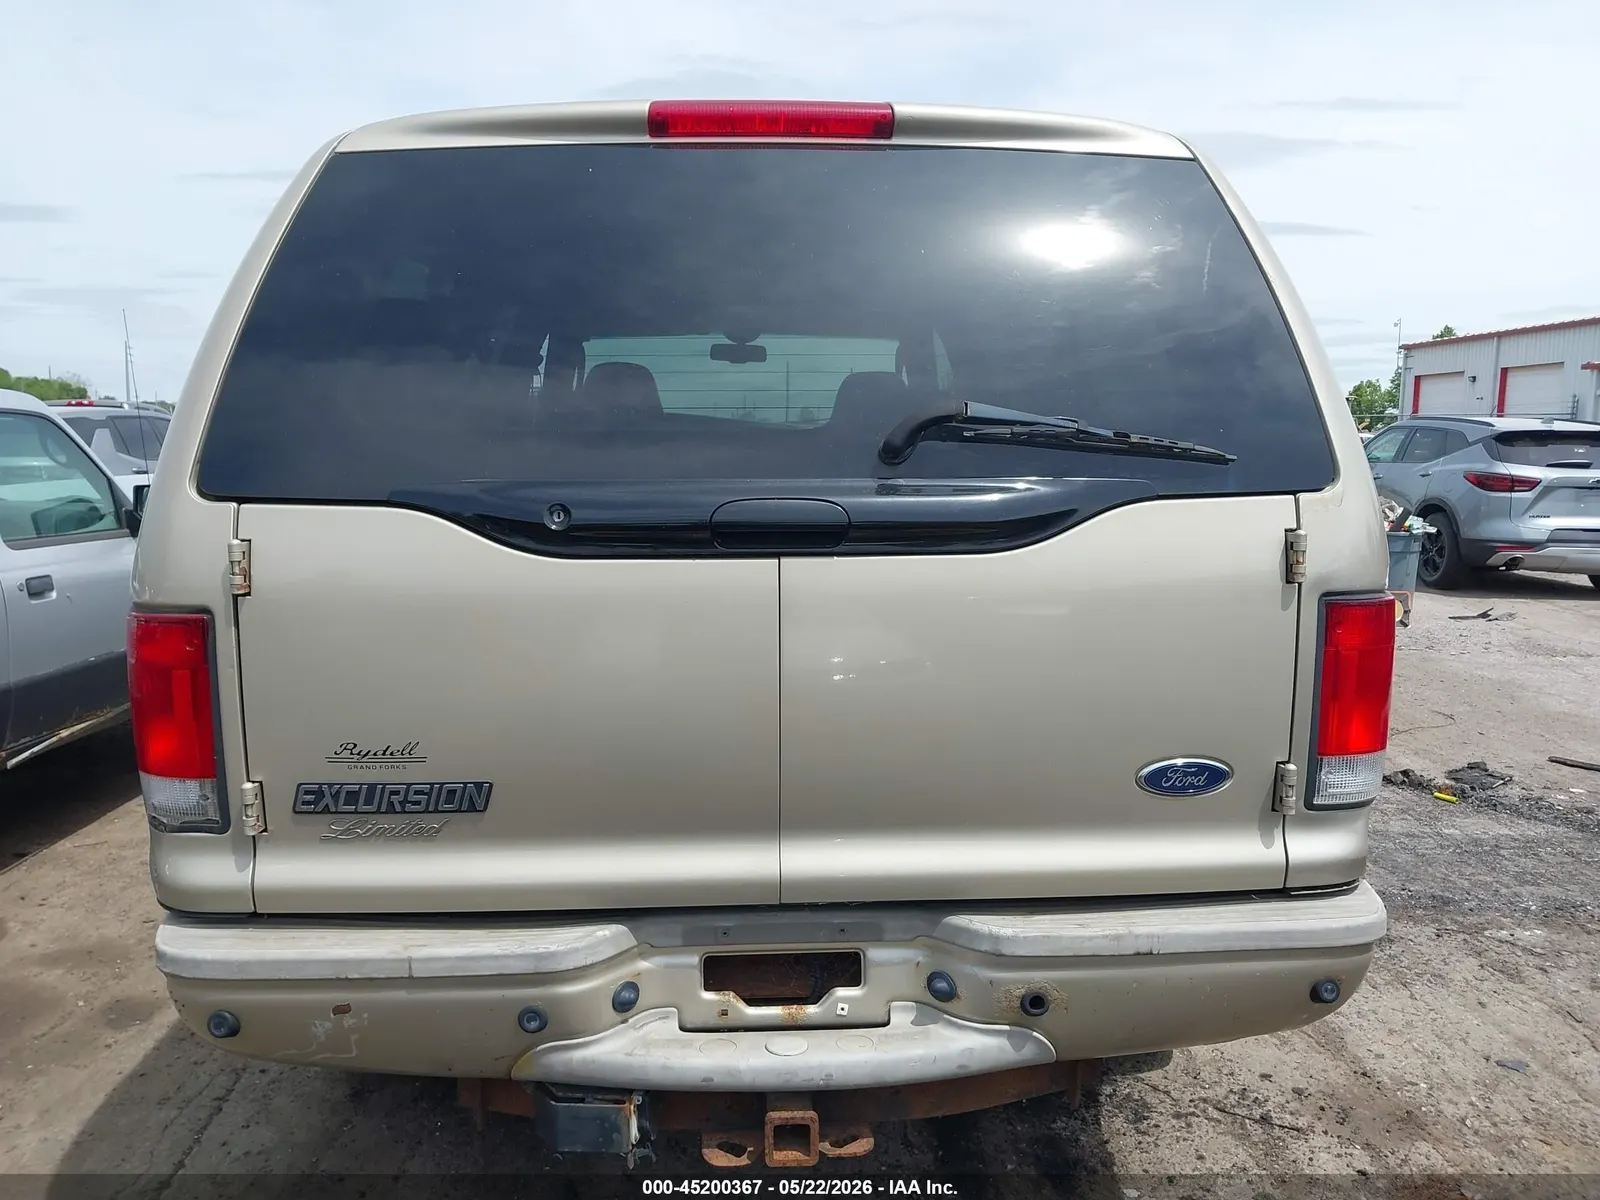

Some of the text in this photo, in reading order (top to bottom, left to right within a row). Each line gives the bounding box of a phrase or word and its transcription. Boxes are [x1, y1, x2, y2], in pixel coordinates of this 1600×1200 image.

[333, 741, 420, 761] Rydell
[1161, 767, 1209, 787] Ford
[294, 783, 490, 812] EXCURSION
[320, 817, 449, 840] Limited
